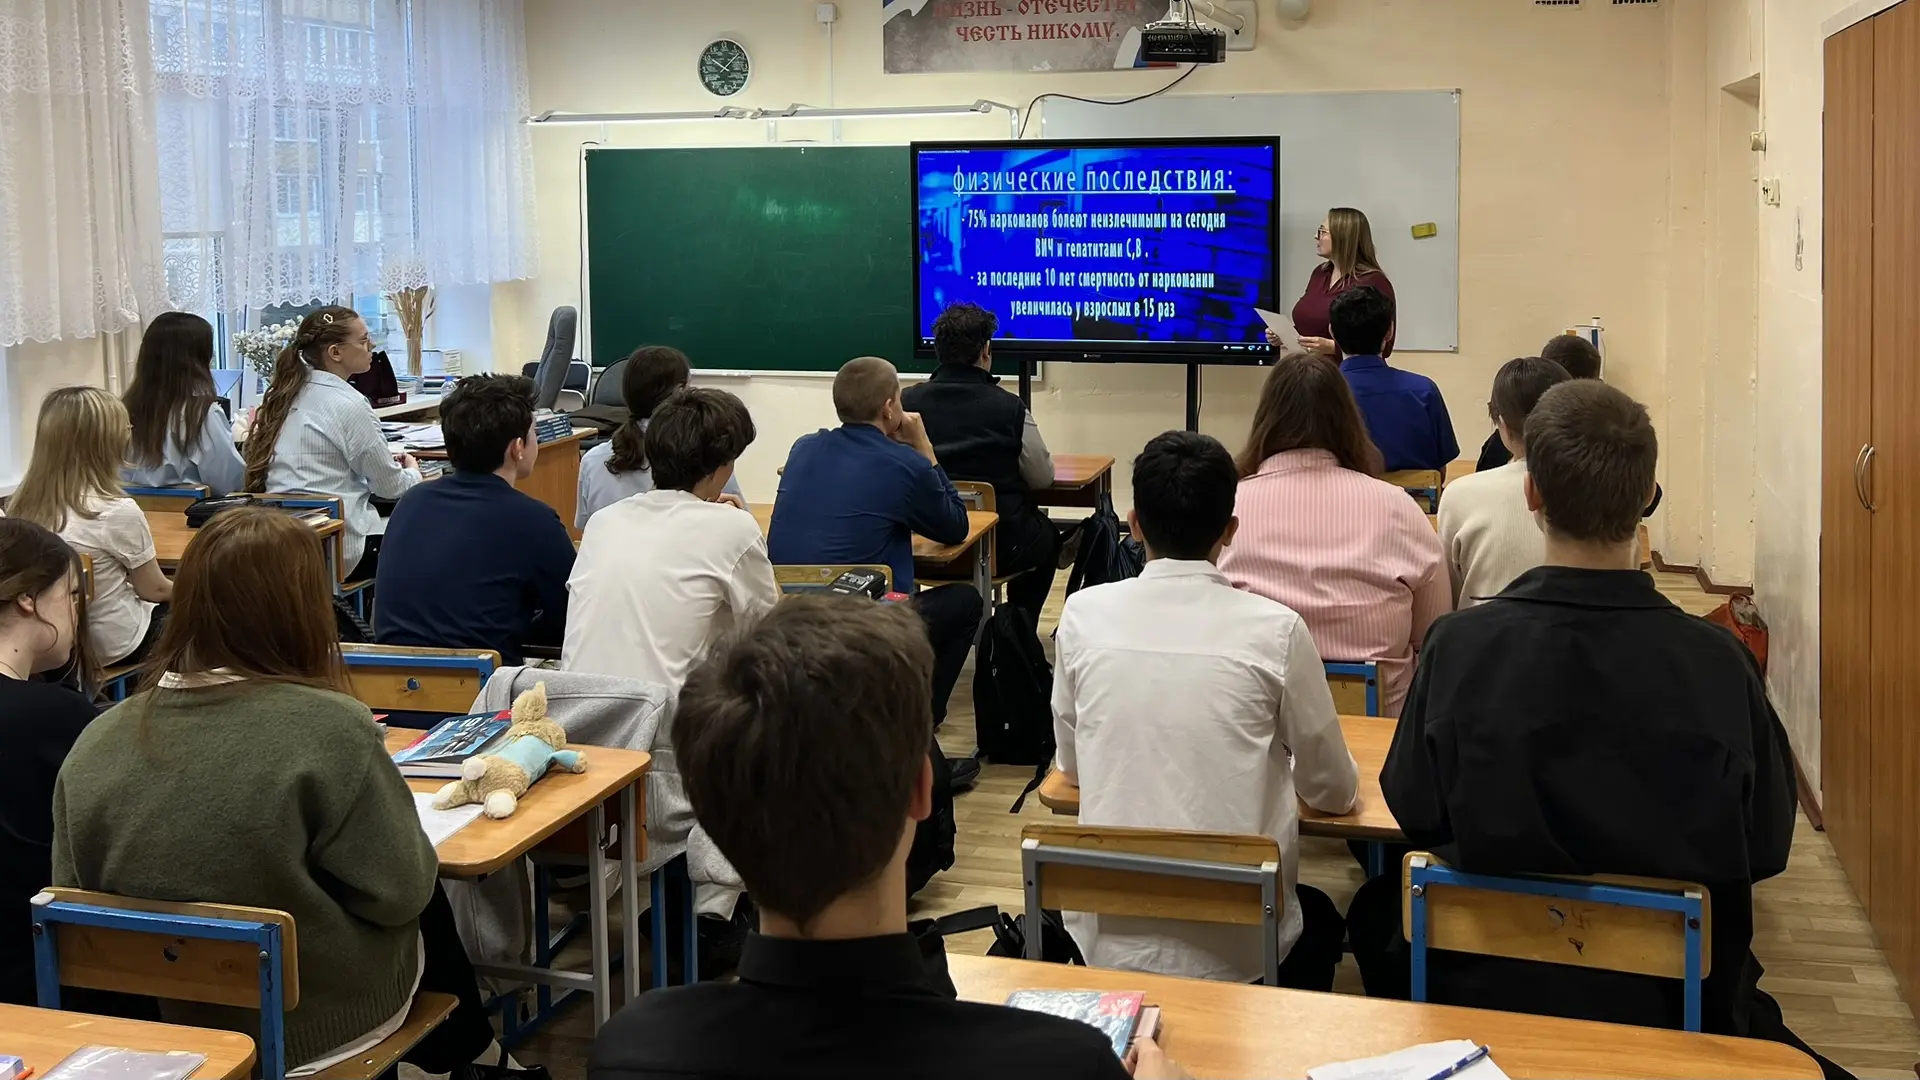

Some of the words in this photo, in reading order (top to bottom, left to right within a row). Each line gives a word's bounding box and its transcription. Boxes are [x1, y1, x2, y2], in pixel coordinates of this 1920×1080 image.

[955, 25, 1022, 42] ЧЕСТЬ
[1027, 21, 1120, 42] НИКОМУ.
[953, 165, 1077, 197] физические
[1086, 168, 1235, 195] последствия:
[968, 209, 987, 228] 75%
[990, 213, 1049, 233] наркоманов
[1052, 208, 1088, 228] болеют
[1090, 212, 1167, 229] неизлечимыми
[1170, 212, 1182, 228] на
[1185, 212, 1226, 232] сегодня
[1035, 237, 1054, 257] ВИЧ
[1057, 242, 1063, 257] и
[1066, 242, 1123, 258] гепатитами
[977, 271, 987, 286] за
[990, 271, 1042, 290] последние
[1045, 267, 1056, 286] 10
[1058, 271, 1075, 287] лет
[1078, 272, 1135, 292] смертность
[1138, 272, 1150, 288] от
[1152, 272, 1214, 293] наркомании
[1010, 300, 1073, 320] увеличилась
[1075, 301, 1081, 322] у
[1083, 301, 1132, 322] взрослых
[1134, 301, 1140, 317] в
[1143, 297, 1155, 318] 15
[1157, 301, 1175, 323] раз
[458, 717, 483, 728] 10
